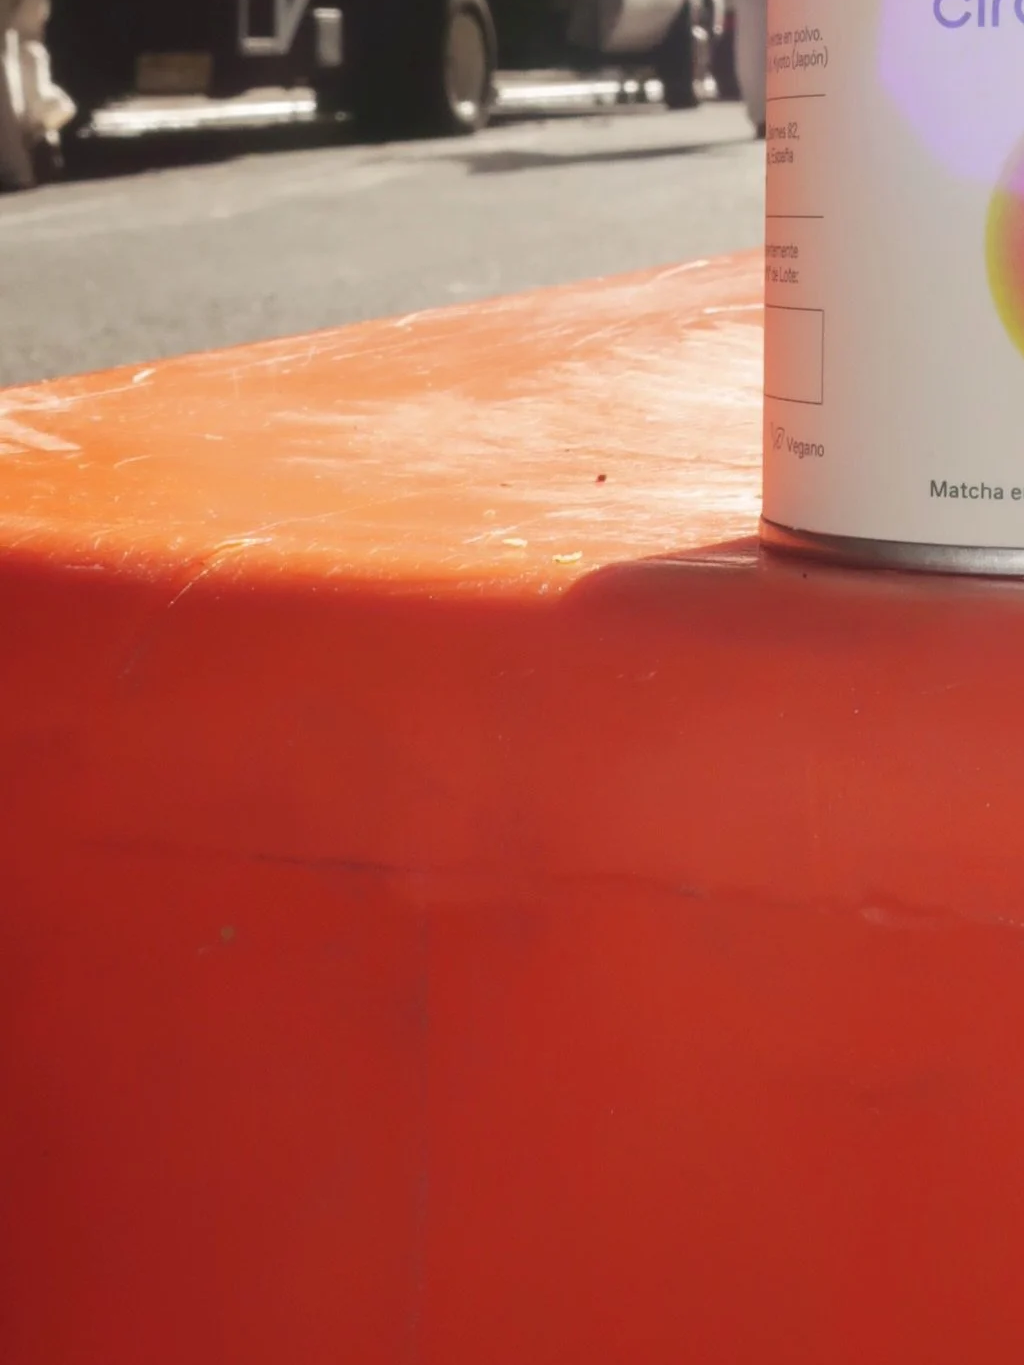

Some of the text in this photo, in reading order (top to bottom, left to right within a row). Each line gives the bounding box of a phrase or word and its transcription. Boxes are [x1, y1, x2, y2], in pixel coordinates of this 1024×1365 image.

[794, 25, 823, 46] polvo.
[786, 436, 825, 459] Vegano
[930, 480, 1004, 500] Matcha
